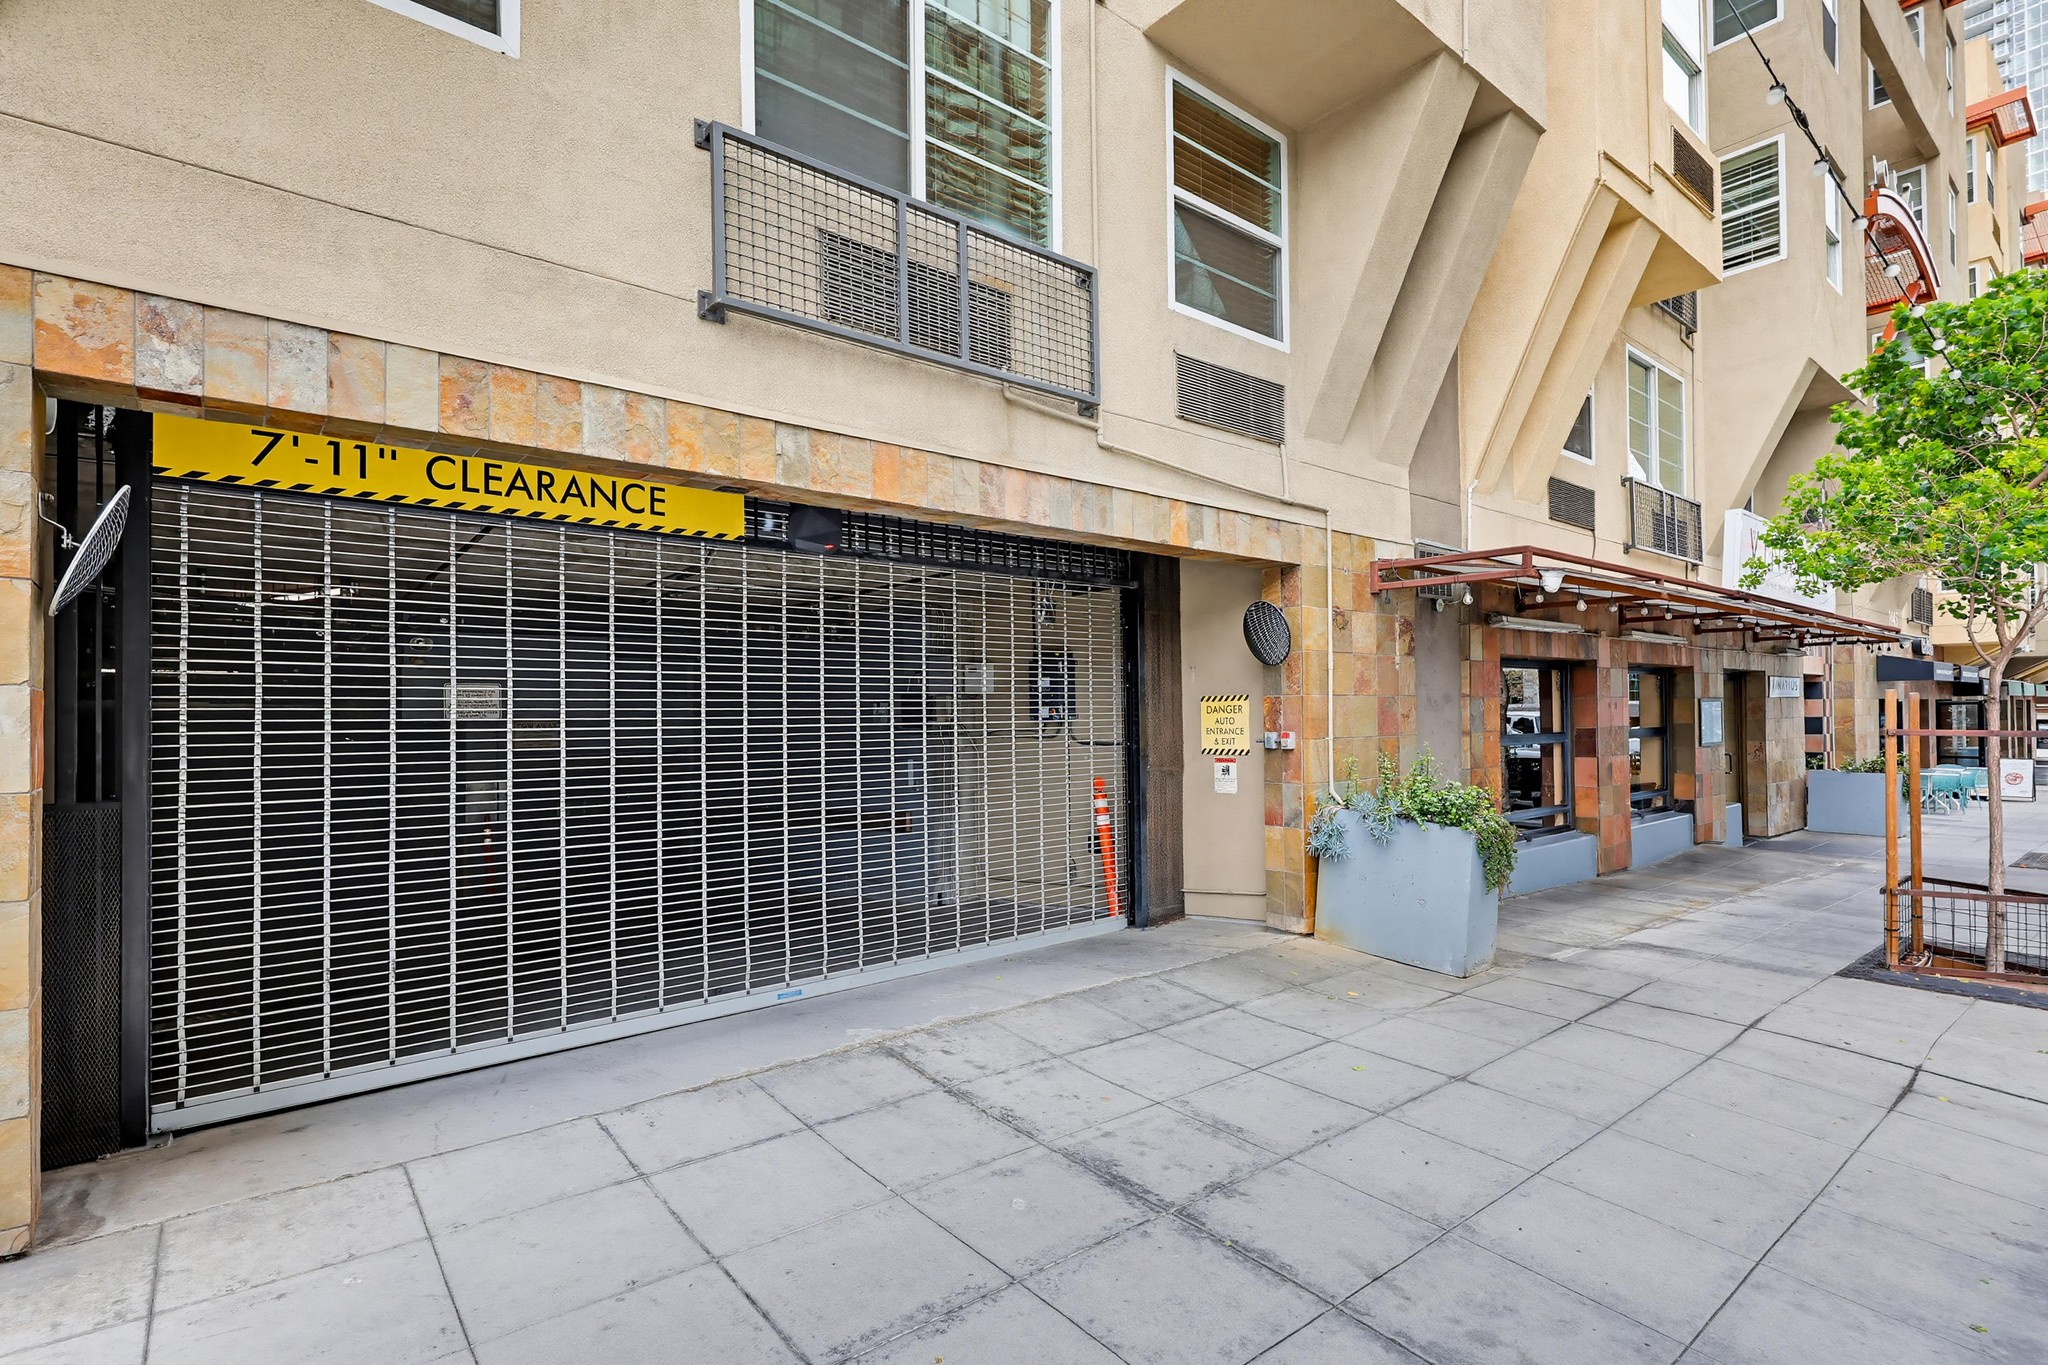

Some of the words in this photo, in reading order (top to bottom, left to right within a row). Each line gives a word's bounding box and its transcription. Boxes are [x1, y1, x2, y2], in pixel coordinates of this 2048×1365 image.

[251, 429, 397, 479] 7'-11"
[425, 455, 666, 517] CLEARANCE
[1206, 704, 1243, 714] DANGER
[1215, 717, 1235, 725] AUTO
[1206, 727, 1244, 735] ENTRANCE
